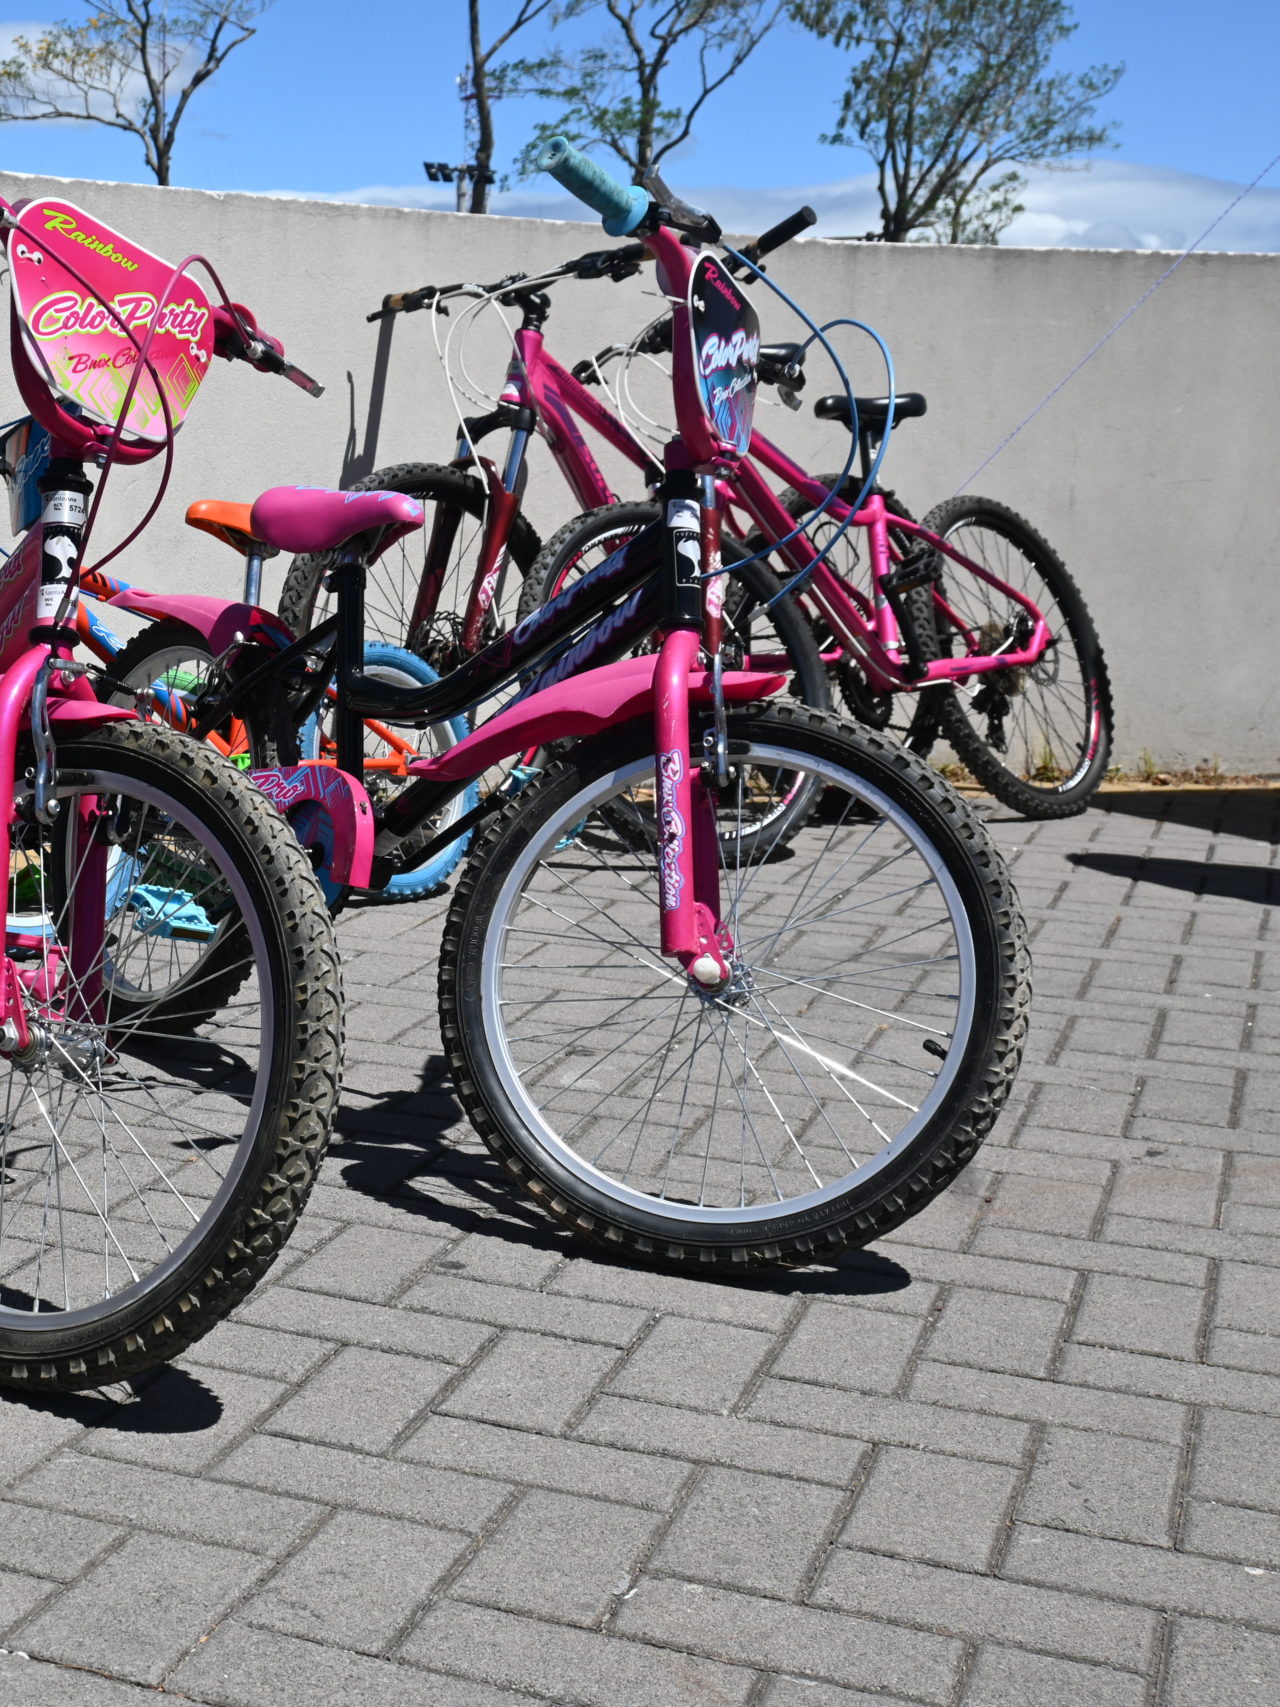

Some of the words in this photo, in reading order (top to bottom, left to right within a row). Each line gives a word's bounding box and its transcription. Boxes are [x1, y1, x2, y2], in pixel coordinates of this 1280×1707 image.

[42, 208, 139, 272] Rainbow
[703, 261, 742, 311] Rainbow
[68, 353, 112, 374] Bmx
